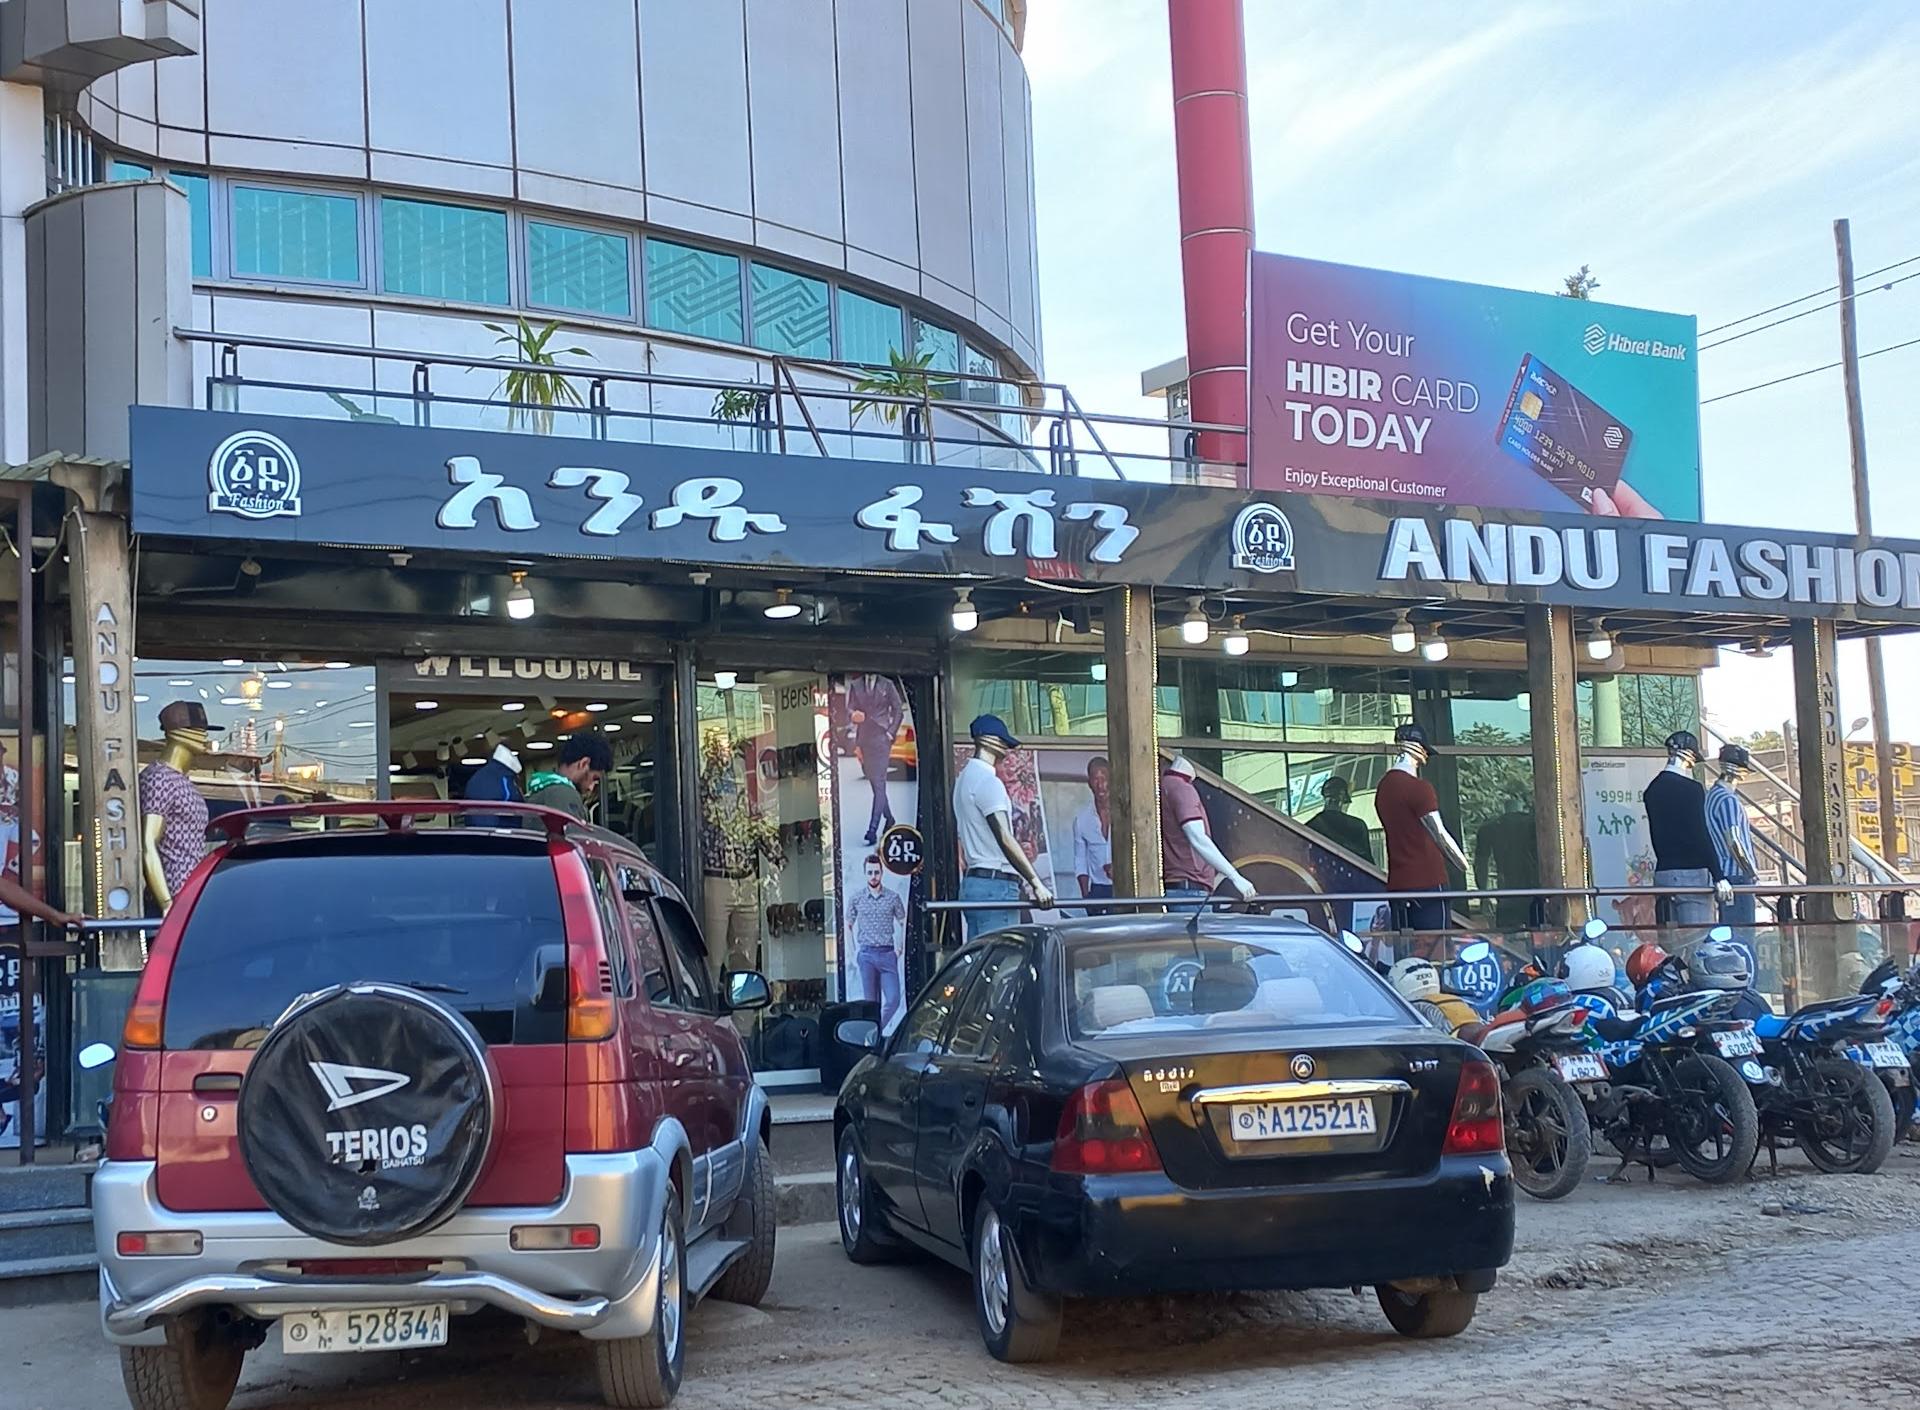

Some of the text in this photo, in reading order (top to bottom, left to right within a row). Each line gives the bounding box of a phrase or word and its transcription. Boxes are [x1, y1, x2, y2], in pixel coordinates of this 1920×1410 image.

[1286, 312, 1415, 358] Get Your
[1607, 333, 1687, 361] Hibret Bank
[1286, 359, 1383, 403] HIBIR
[1391, 374, 1480, 413] CARD
[1285, 400, 1432, 454] TODAY
[229, 492, 285, 511] Fashion
[1285, 467, 1447, 497] Enjoy Exceptional Customer
[435, 455, 1141, 564] አንዱ ፋሽን
[1248, 552, 1285, 568] Fashion
[1377, 516, 1620, 591] ANDU
[96, 602, 120, 714] ANDU
[1822, 671, 1837, 747] ANDU
[1597, 812, 1636, 836] ኢትዮ
[1271, 1101, 1357, 1133] A12521
[326, 1124, 428, 1164] TERIOS
[348, 1306, 428, 1345] 52834
